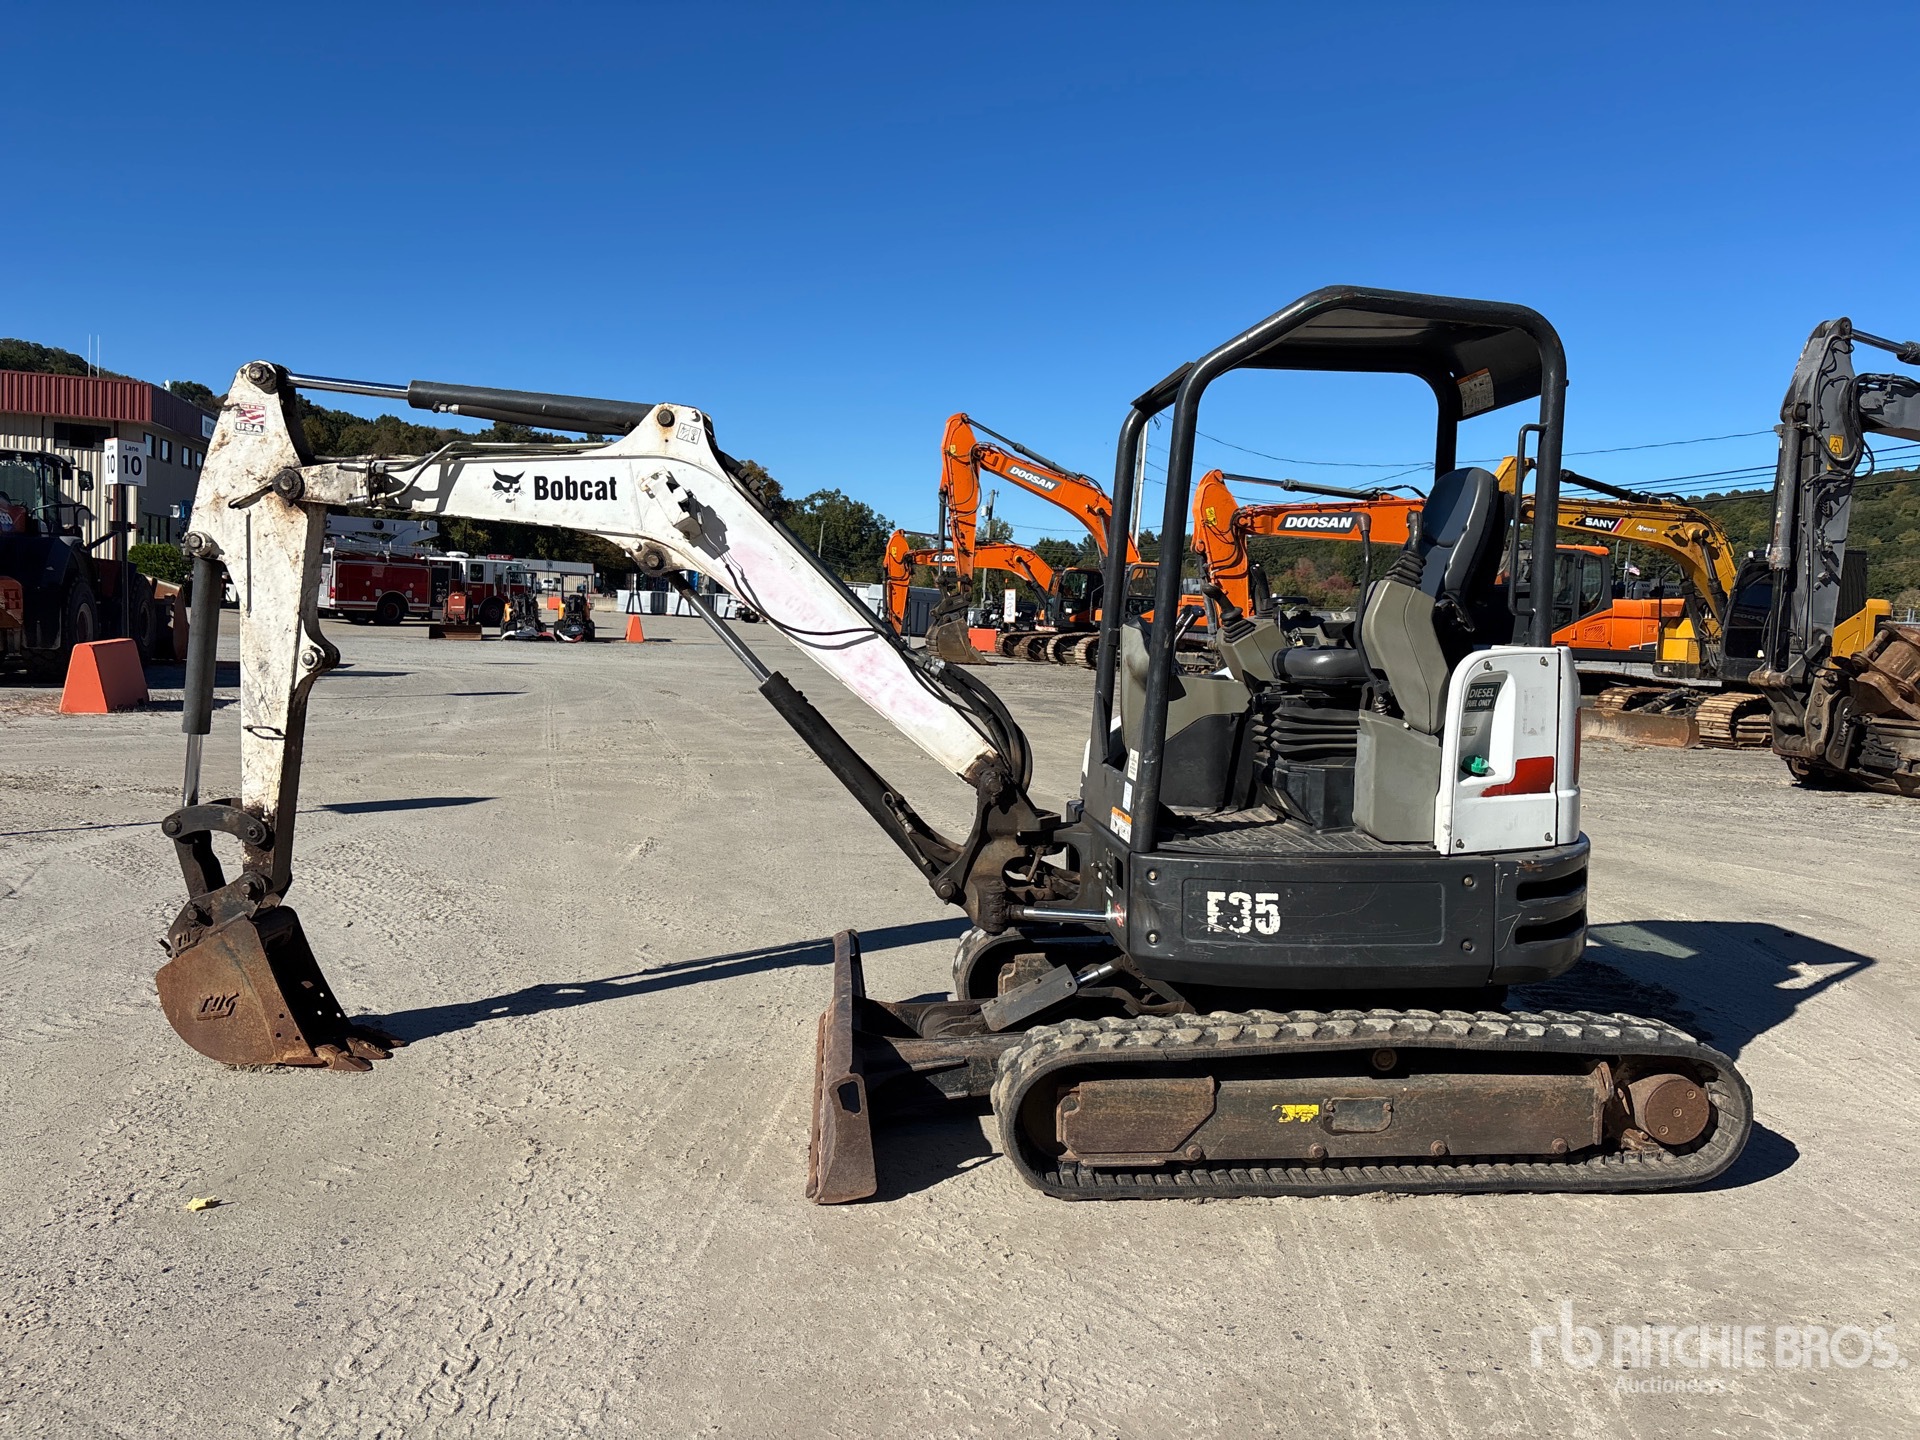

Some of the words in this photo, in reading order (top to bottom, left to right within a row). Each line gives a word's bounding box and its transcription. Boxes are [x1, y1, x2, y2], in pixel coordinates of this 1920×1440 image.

[236, 422, 262, 432] USA
[124, 444, 140, 452] Lane
[106, 454, 116, 474] 10
[122, 454, 143, 476] 10
[1009, 466, 1056, 490] DOOSAN
[533, 475, 618, 501] Bobcat
[1285, 516, 1353, 529] DOOSAN
[1585, 517, 1615, 529] SANY
[1469, 687, 1495, 699] DIESEL
[1465, 699, 1478, 708] FUEL
[1477, 699, 1492, 707] ONLY
